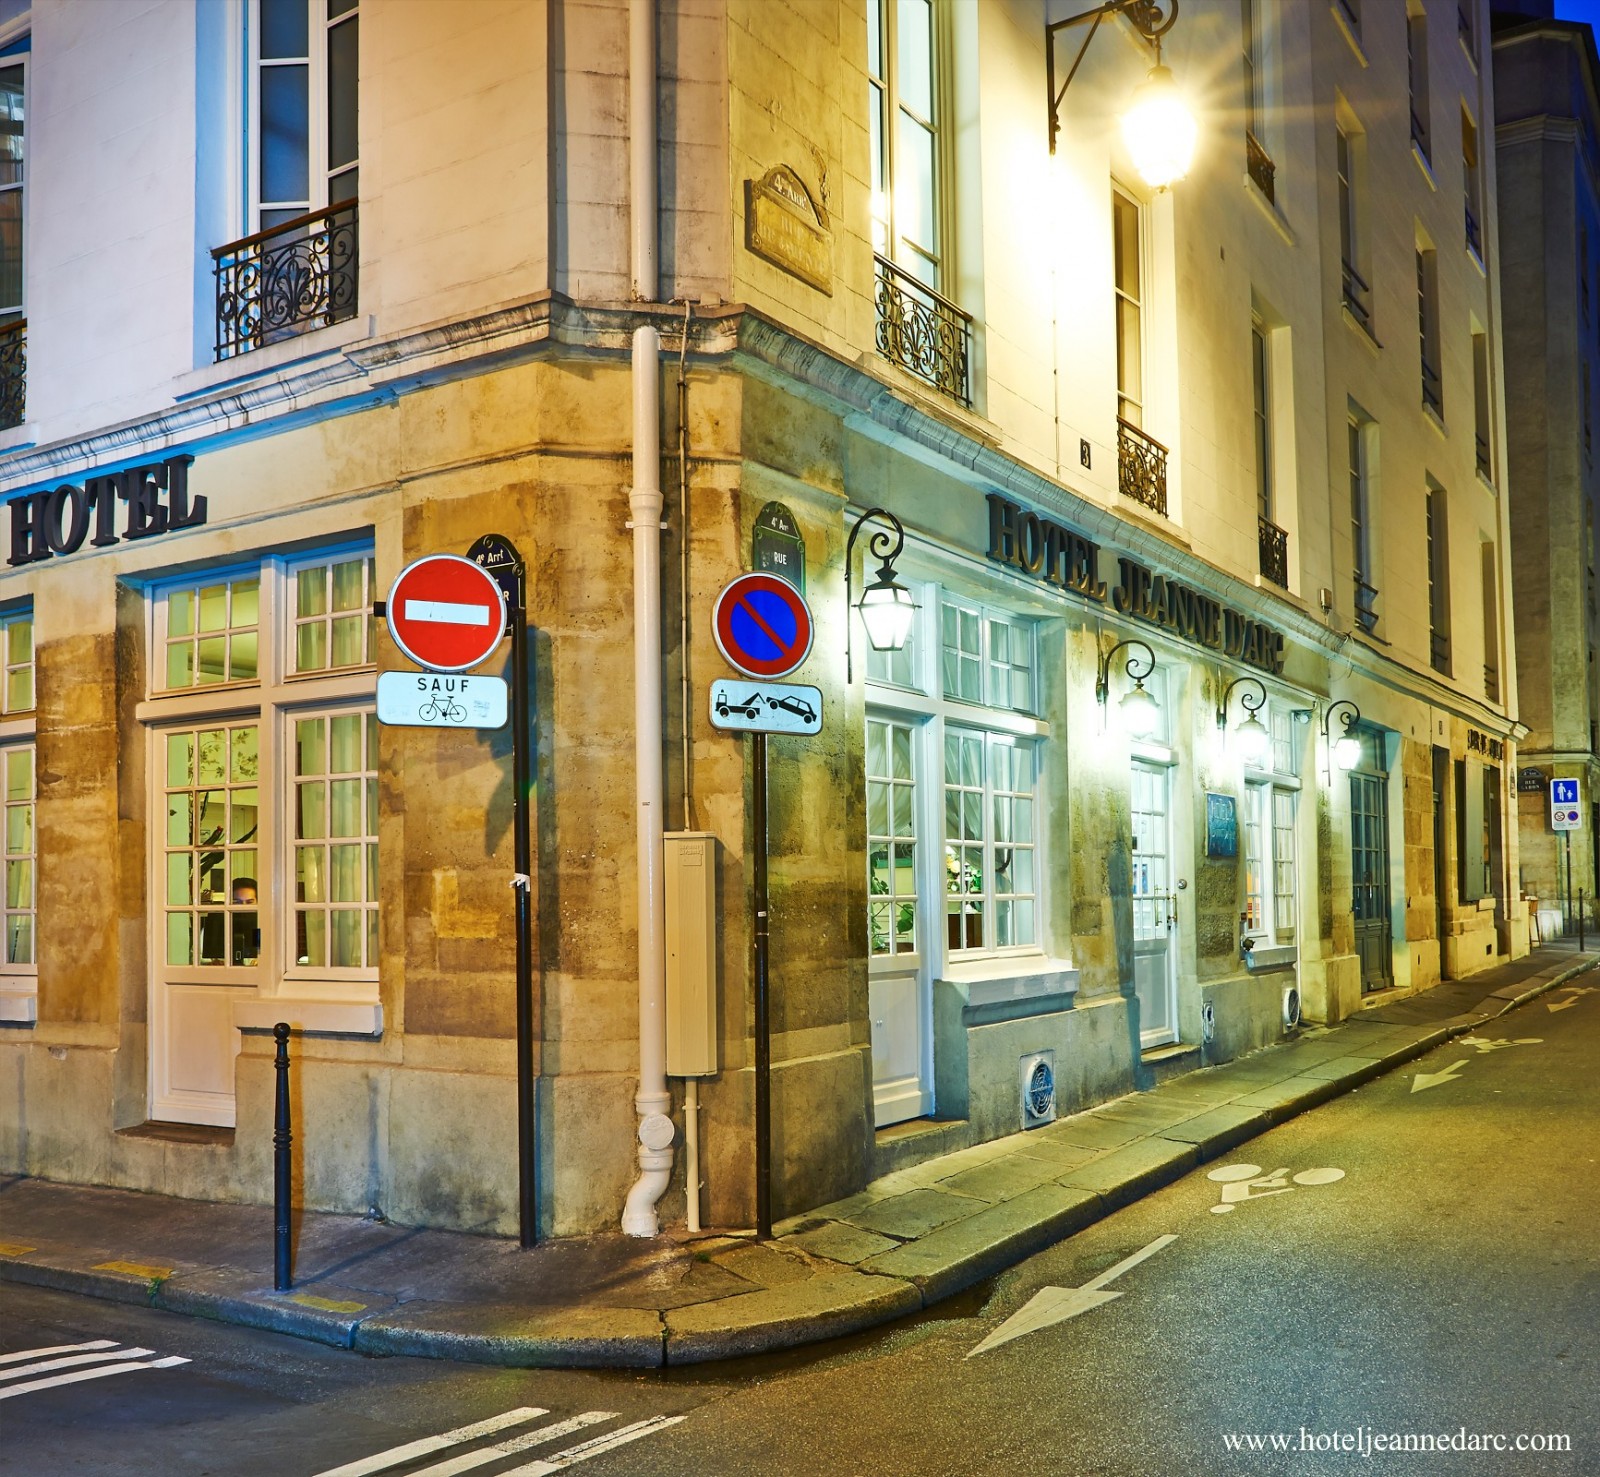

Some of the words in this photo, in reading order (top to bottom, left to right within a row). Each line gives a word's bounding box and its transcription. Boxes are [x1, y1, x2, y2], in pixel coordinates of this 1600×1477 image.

[1082, 444, 1090, 467] 3
[6, 453, 208, 565] HOTEL
[475, 553, 485, 565] 4e
[487, 548, 504, 564] Arrt
[773, 551, 787, 565] RUE
[985, 493, 1108, 602] HOTEL
[1113, 557, 1222, 650] JEANNE
[1223, 607, 1285, 674] D'ARC
[417, 677, 470, 693] SAUF
